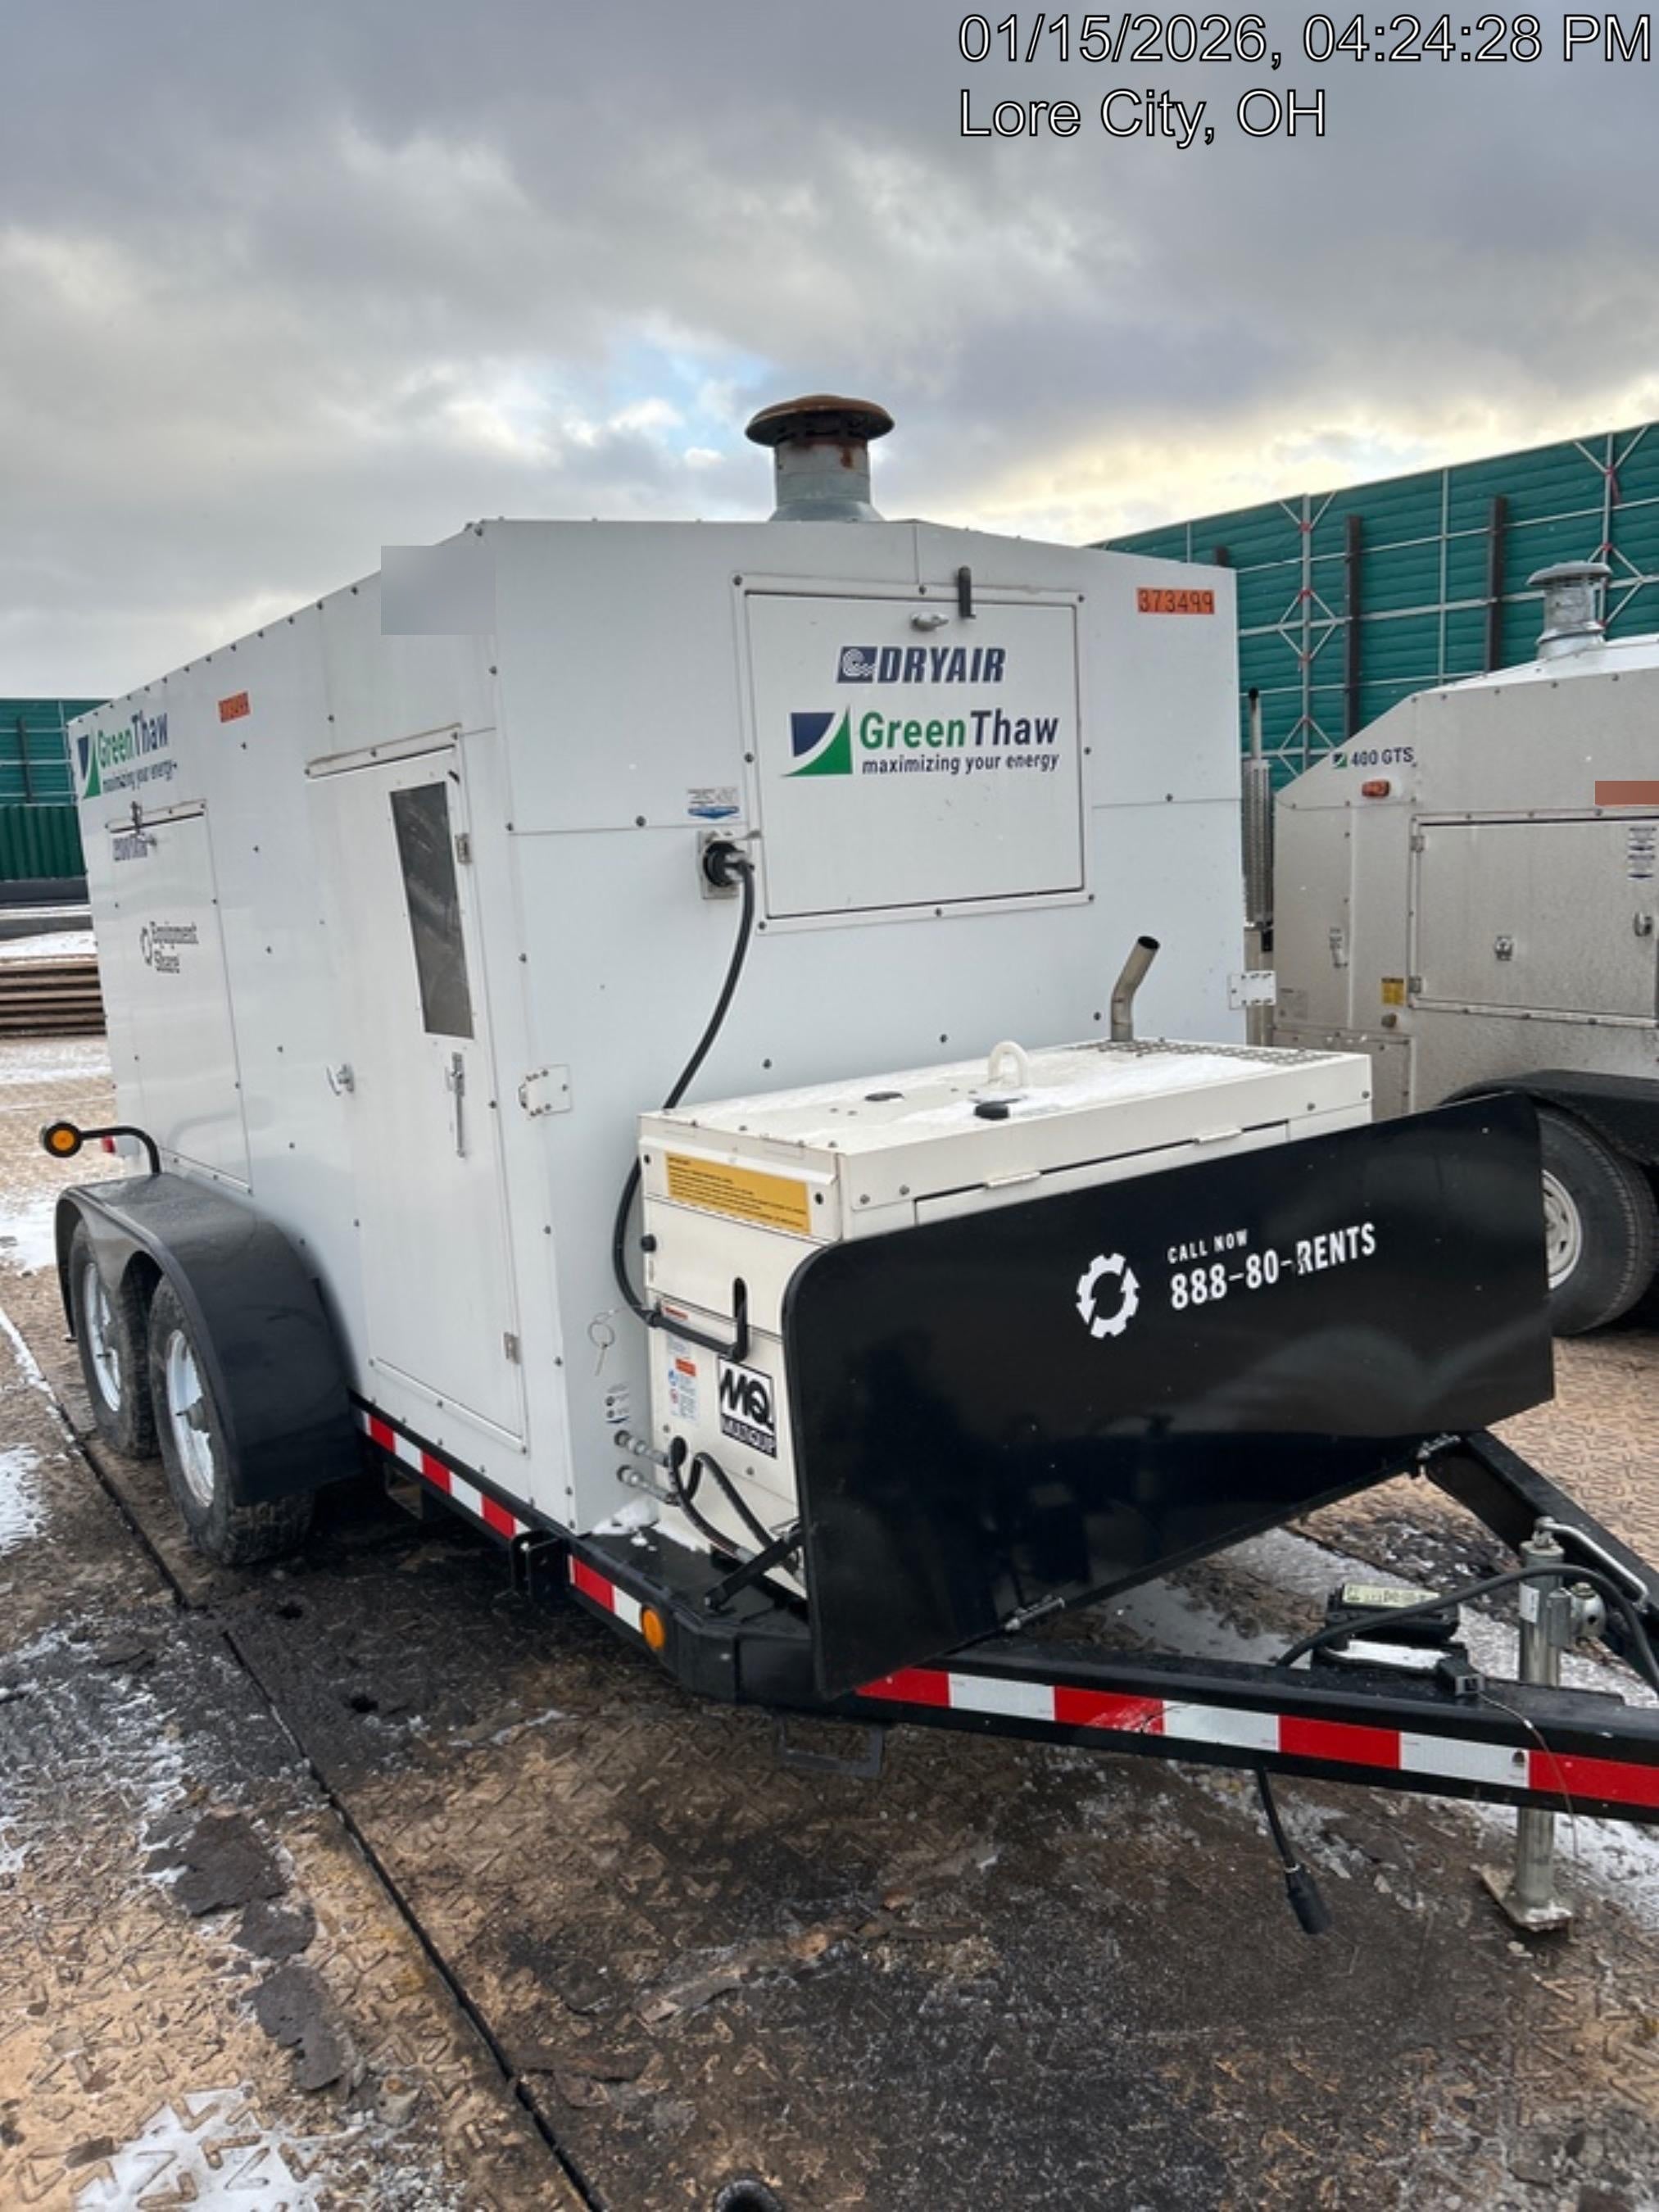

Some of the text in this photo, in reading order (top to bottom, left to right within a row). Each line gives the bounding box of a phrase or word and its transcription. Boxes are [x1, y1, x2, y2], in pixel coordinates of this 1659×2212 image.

[1138, 589, 1213, 614] 373499
[877, 646, 1006, 684] DRYAIR
[862, 753, 1060, 775] maximizing your energy
[1351, 746, 1414, 767] 400 GTS
[1167, 1229, 1249, 1264] CALL NOW
[1171, 1222, 1376, 1310] 888-80-RENTS
